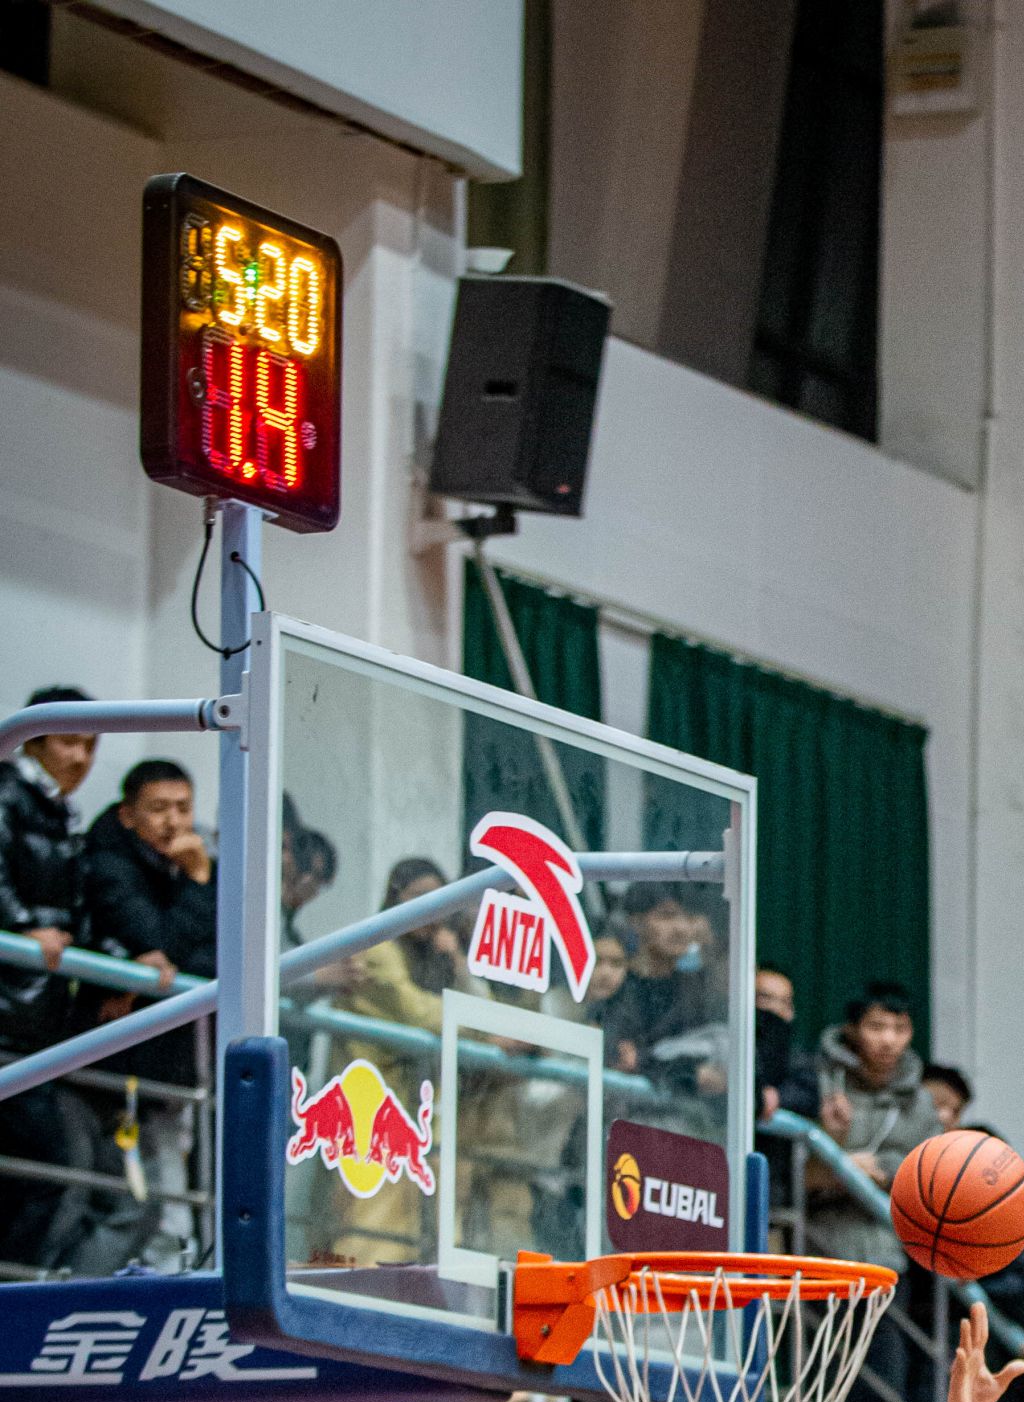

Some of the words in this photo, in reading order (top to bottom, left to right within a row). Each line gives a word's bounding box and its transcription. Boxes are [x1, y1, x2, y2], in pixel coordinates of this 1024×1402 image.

[475, 903, 546, 979] ANTA
[643, 1176, 725, 1229] CUBAL
[0, 1308, 317, 1387] 金陵
